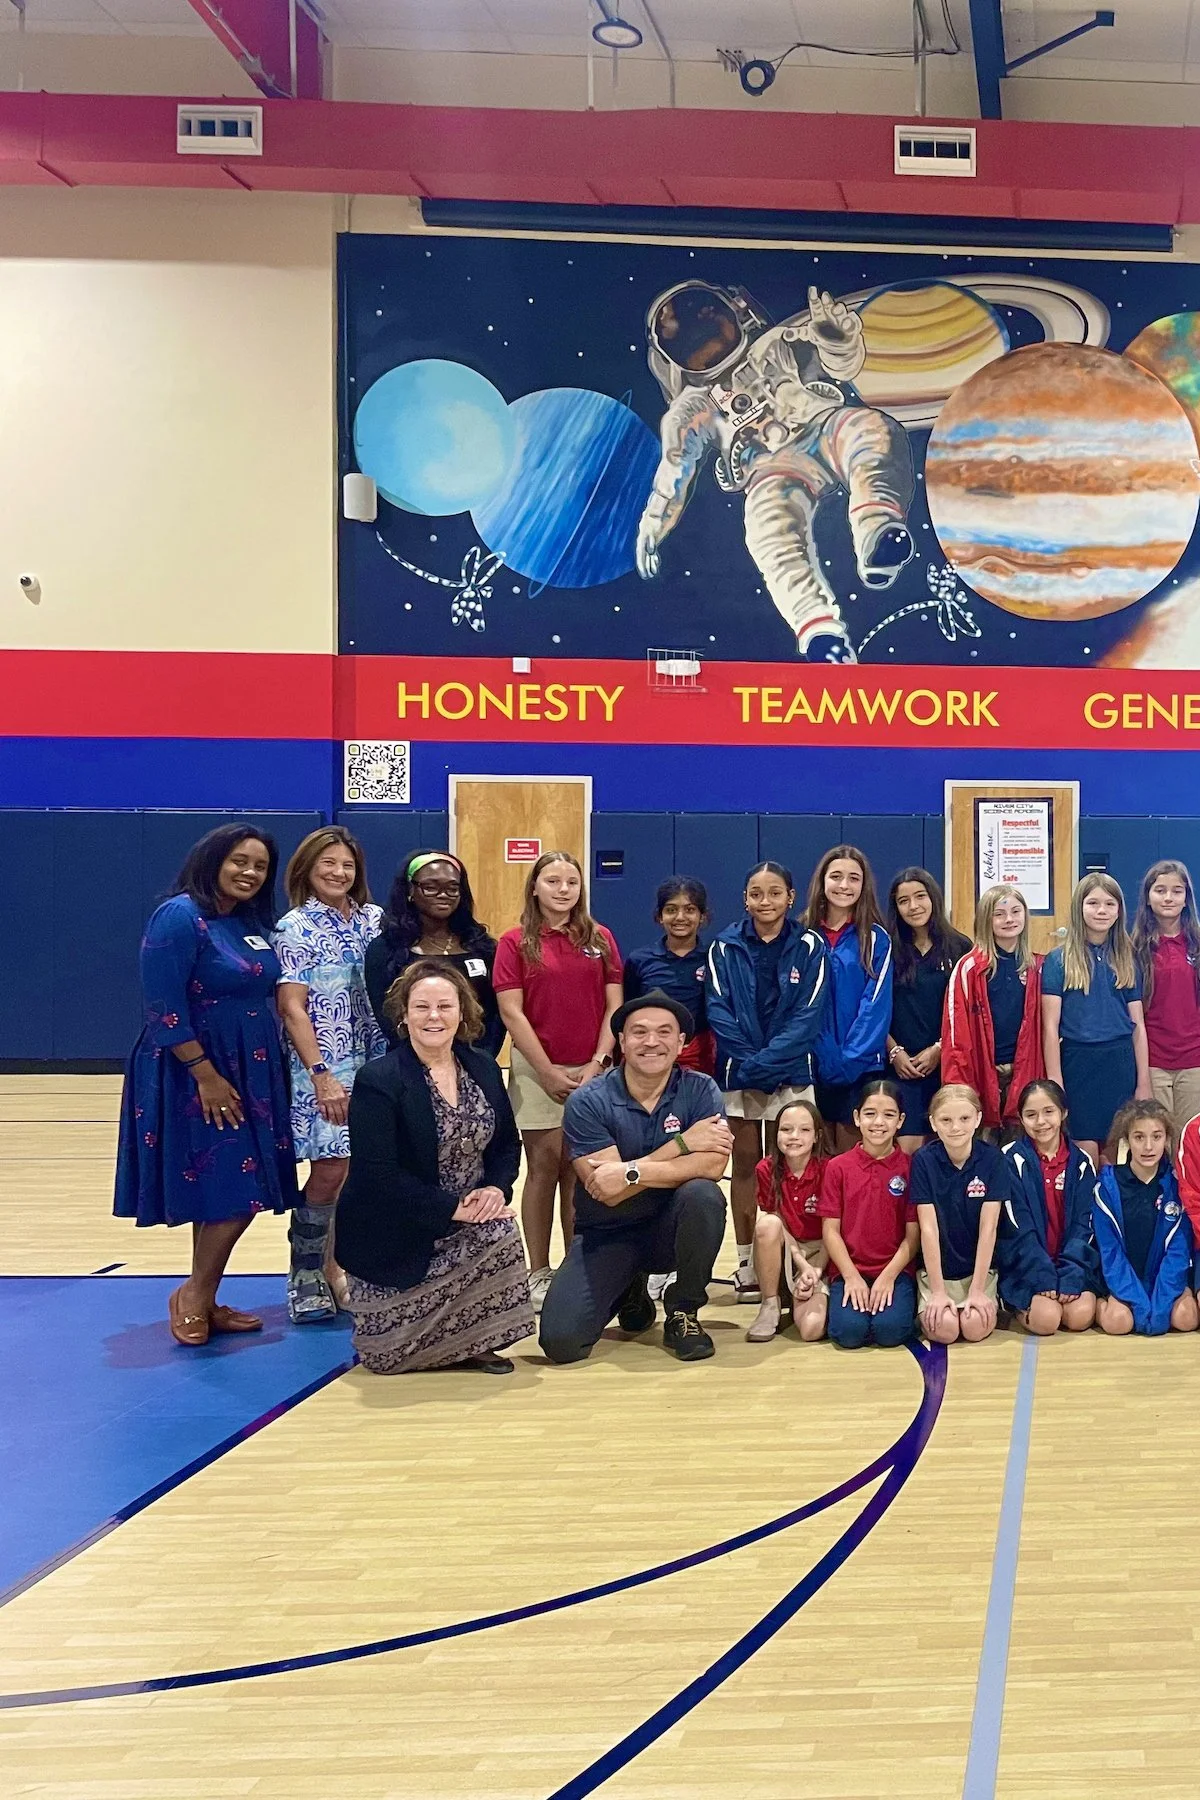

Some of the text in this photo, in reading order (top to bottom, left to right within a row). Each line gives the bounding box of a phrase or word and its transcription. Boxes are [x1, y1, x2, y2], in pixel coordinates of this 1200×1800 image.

[398, 682, 624, 721] HONESTY
[733, 687, 1000, 727] TEAMWORK
[1002, 819, 1040, 828] Respectful
[1002, 847, 1045, 856] Responsible
[1002, 874, 1018, 882] Safe
